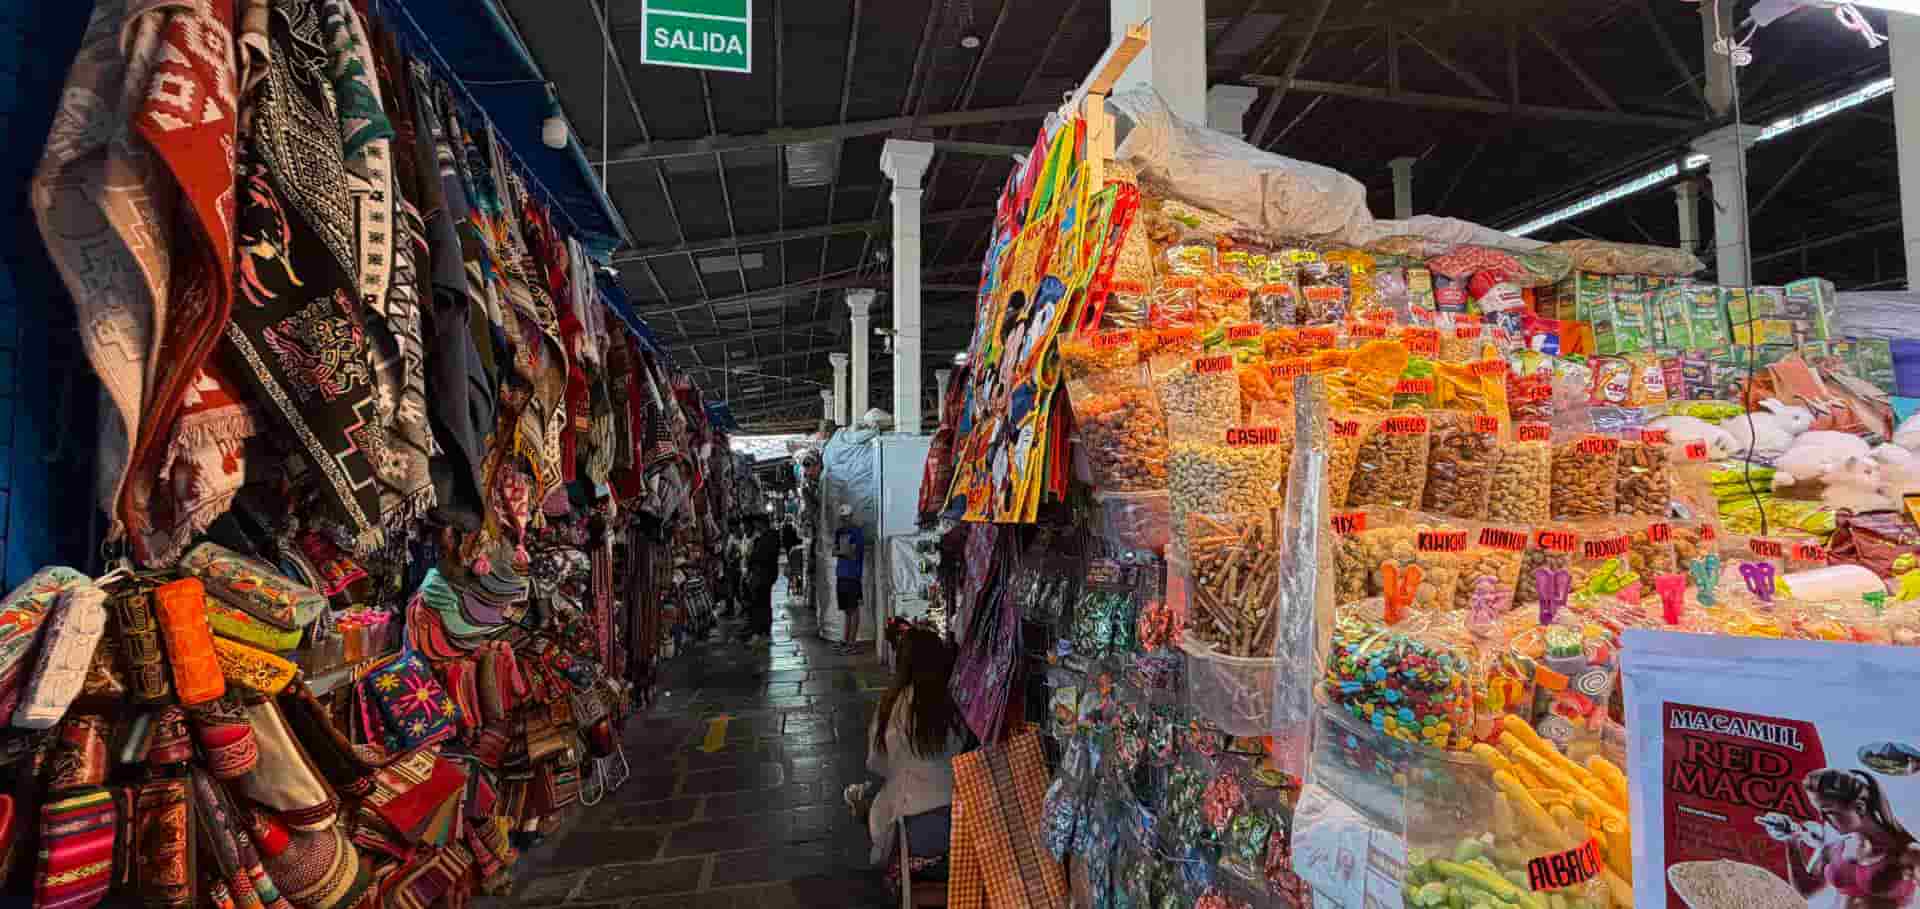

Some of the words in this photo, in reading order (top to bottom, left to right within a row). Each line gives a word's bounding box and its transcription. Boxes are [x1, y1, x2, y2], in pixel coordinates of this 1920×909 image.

[653, 27, 744, 56] SALIDA
[1670, 708, 1804, 751] MACAMIL
[1683, 735, 1793, 779] RED
[1671, 763, 1811, 820] MACA
